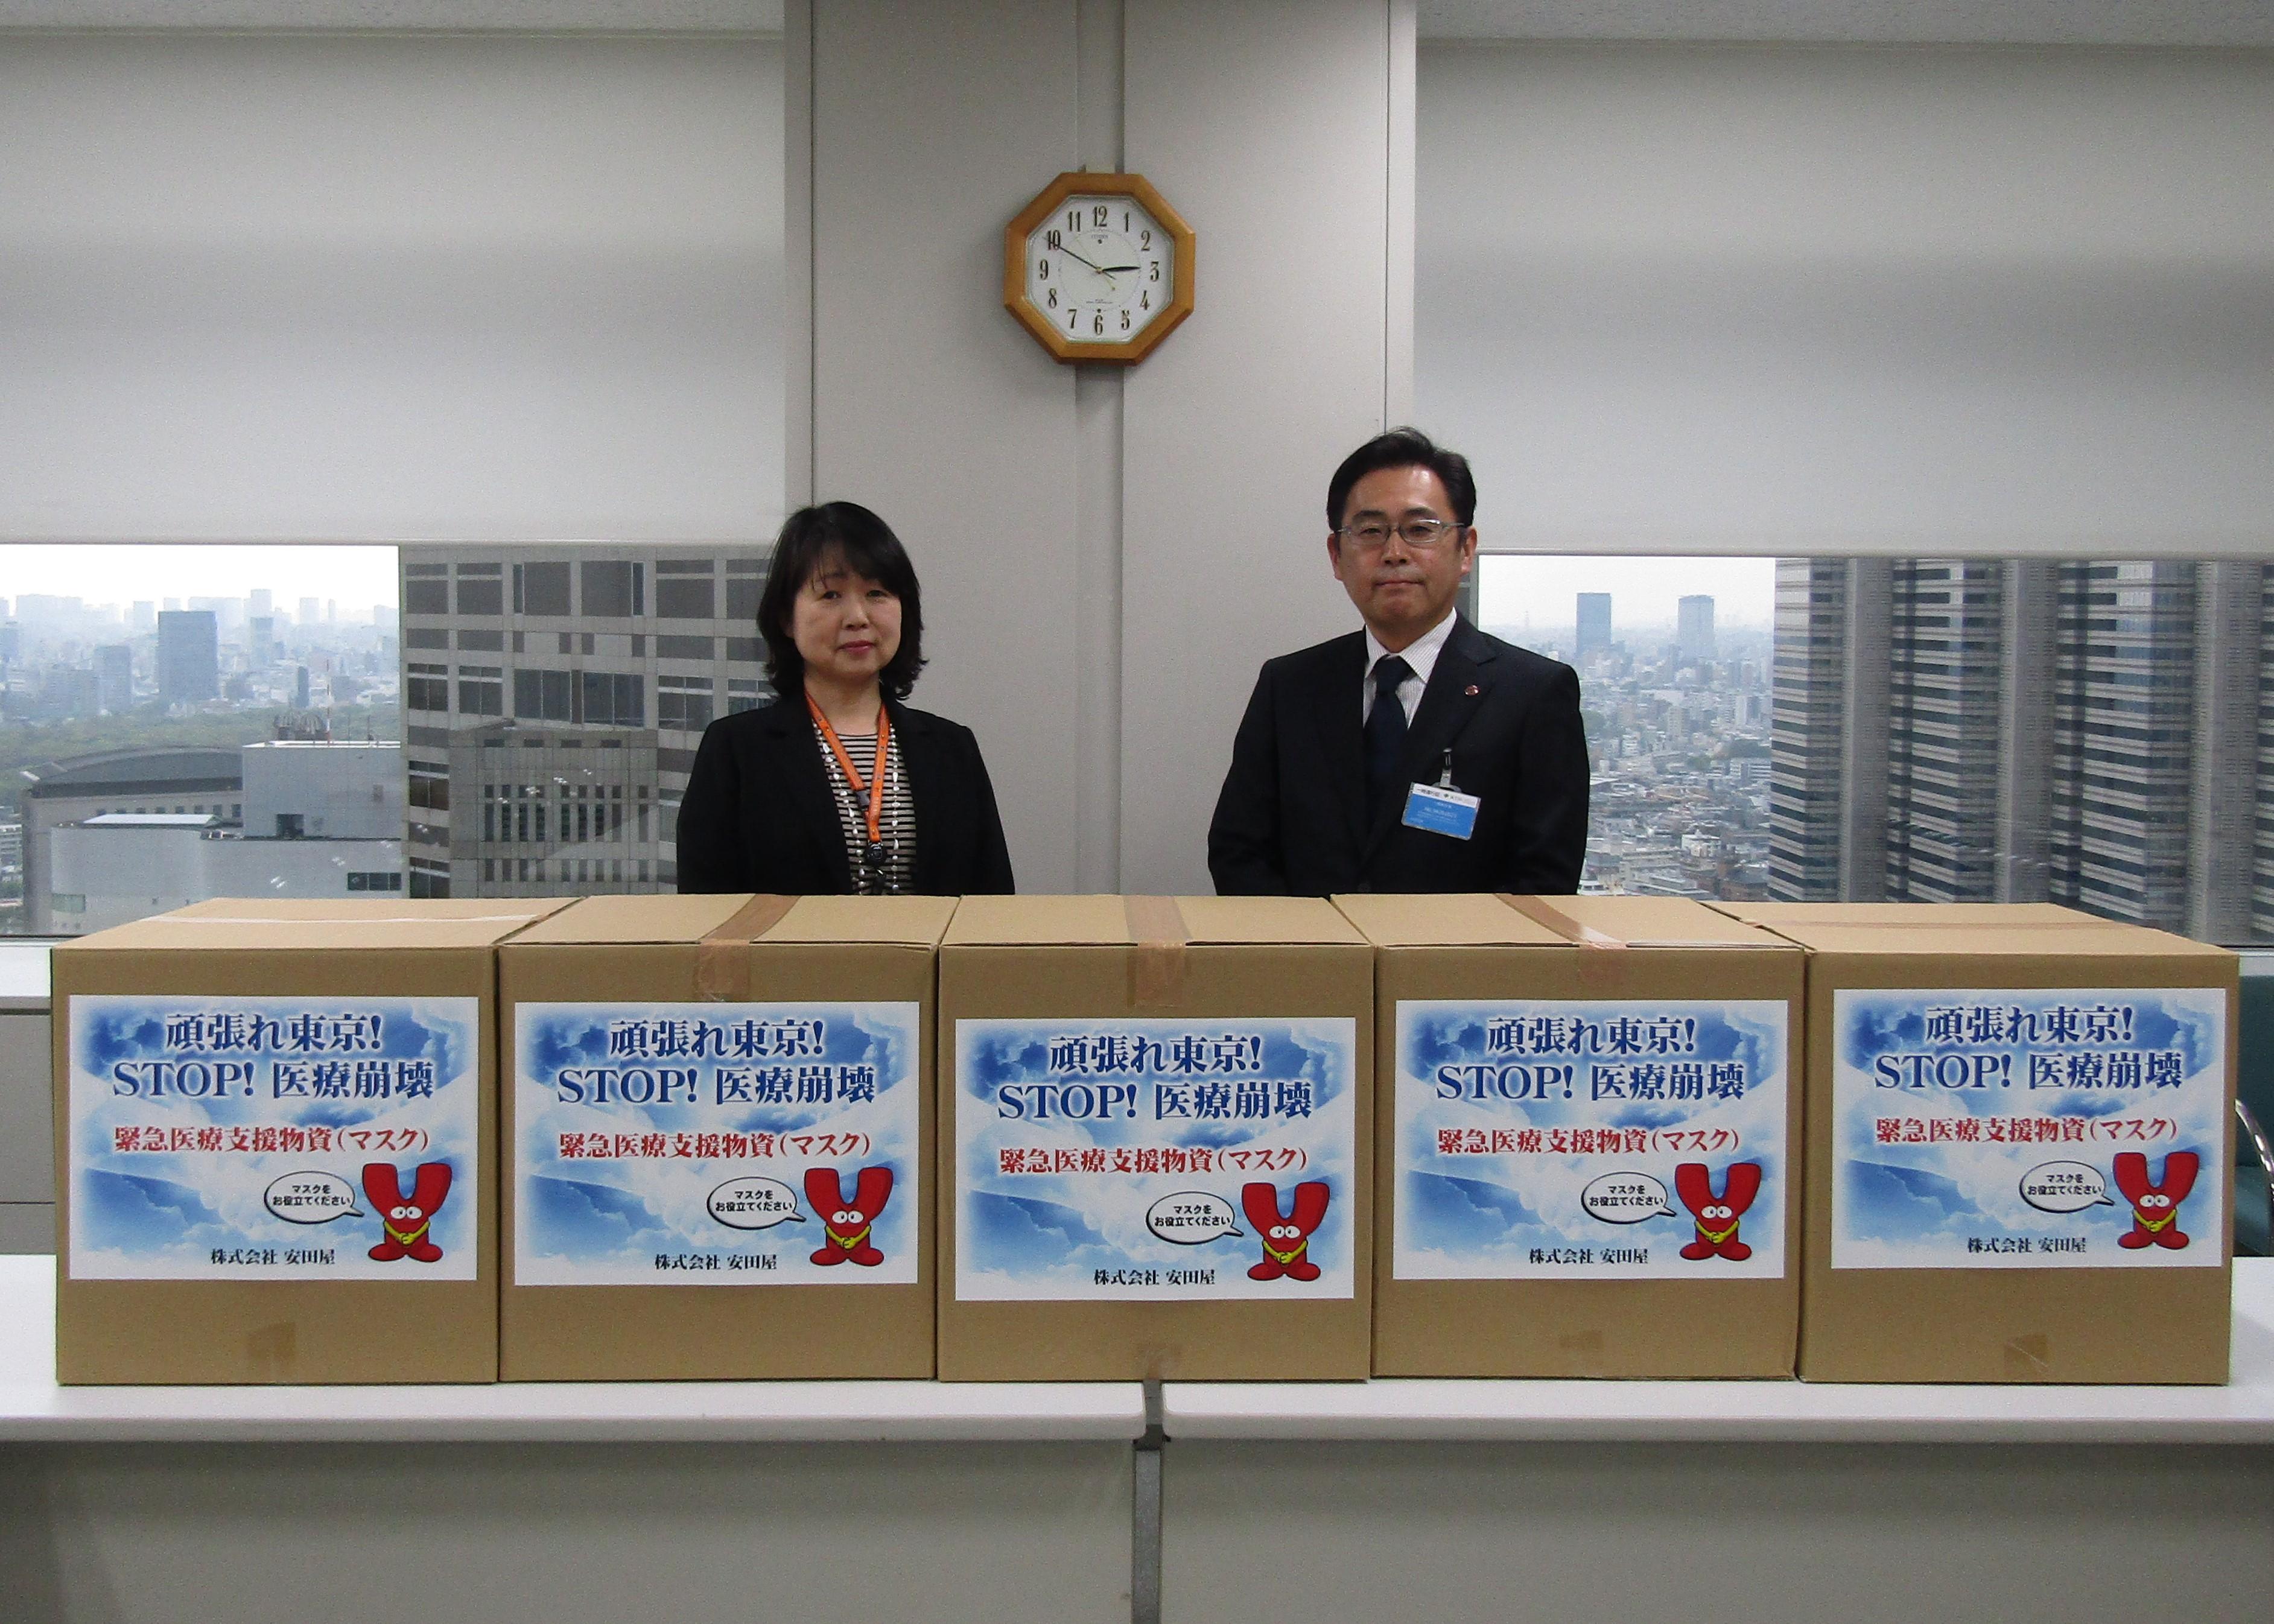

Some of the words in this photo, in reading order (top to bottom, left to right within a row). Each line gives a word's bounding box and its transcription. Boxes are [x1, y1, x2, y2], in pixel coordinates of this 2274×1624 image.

[1067, 212, 1081, 232] 11
[1093, 206, 1107, 227] 12
[1124, 212, 1129, 232] 1
[1047, 230, 1060, 250] 10
[1141, 230, 1150, 251] 2
[1040, 259, 1048, 280] 9
[1151, 261, 1159, 281] 3
[1049, 288, 1056, 308] 8
[1140, 290, 1149, 309] 4
[1068, 309, 1077, 328] 7
[1094, 314, 1102, 334] 6
[1122, 310, 1129, 330] 5
[165, 1013, 381, 1051] 頑張れ東京!
[1926, 1006, 2132, 1044] 頑張れ東京!
[610, 1020, 824, 1058] 頑張れ東京!
[1487, 1017, 1695, 1055] 頑張れ東京!
[1050, 1036, 1261, 1073] 頑張れ東京!
[113, 1062, 253, 1097] STOP!
[272, 1061, 433, 1099] 医療崩壊
[1875, 1053, 2010, 1089] STOP!
[2028, 1053, 2182, 1090] 医療崩壊
[557, 1068, 696, 1103] STOP!
[717, 1067, 875, 1105] 医療崩壊
[1436, 1065, 1573, 1100] STOP!
[1591, 1063, 1744, 1101] 医療崩壊
[998, 1083, 1136, 1119] STOP!
[1155, 1082, 1312, 1120] 医療崩壊
[115, 1127, 430, 1153] 緊急医療支援物資(マスク)
[1876, 1117, 2177, 1143] 緊急医療支援物資(マスク)
[559, 1132, 870, 1158] 緊急医療支援物資(マスク)
[1438, 1128, 1740, 1154] 緊急医療支援物資(マスク)
[1000, 1147, 1307, 1174] 緊急医療支援物資(マスク)
[292, 1184, 331, 1194] マスクを
[2047, 1174, 2083, 1184] マスクを
[734, 1190, 772, 1200] マスクを
[1609, 1185, 1645, 1194] マスクを
[2028, 1184, 2101, 1195] お役立てください
[273, 1196, 351, 1206] お役立てください
[716, 1201, 793, 1211] お役立てください
[1173, 1205, 1212, 1214] マスクを
[1589, 1196, 1664, 1207] お役立てください
[1154, 1216, 1231, 1226] お役立てください
[1968, 1237, 2032, 1253] 株式会社
[2039, 1237, 2086, 1253] 安田屋
[211, 1249, 278, 1265] 株式会社
[284, 1249, 335, 1265] 安田屋
[655, 1254, 720, 1269] 株式会社
[728, 1254, 778, 1269] 安田屋
[1529, 1249, 1595, 1264] 株式会社
[1600, 1249, 1649, 1264] 安田屋
[1093, 1269, 1160, 1285] 株式会社
[1166, 1269, 1216, 1285] 安田屋
